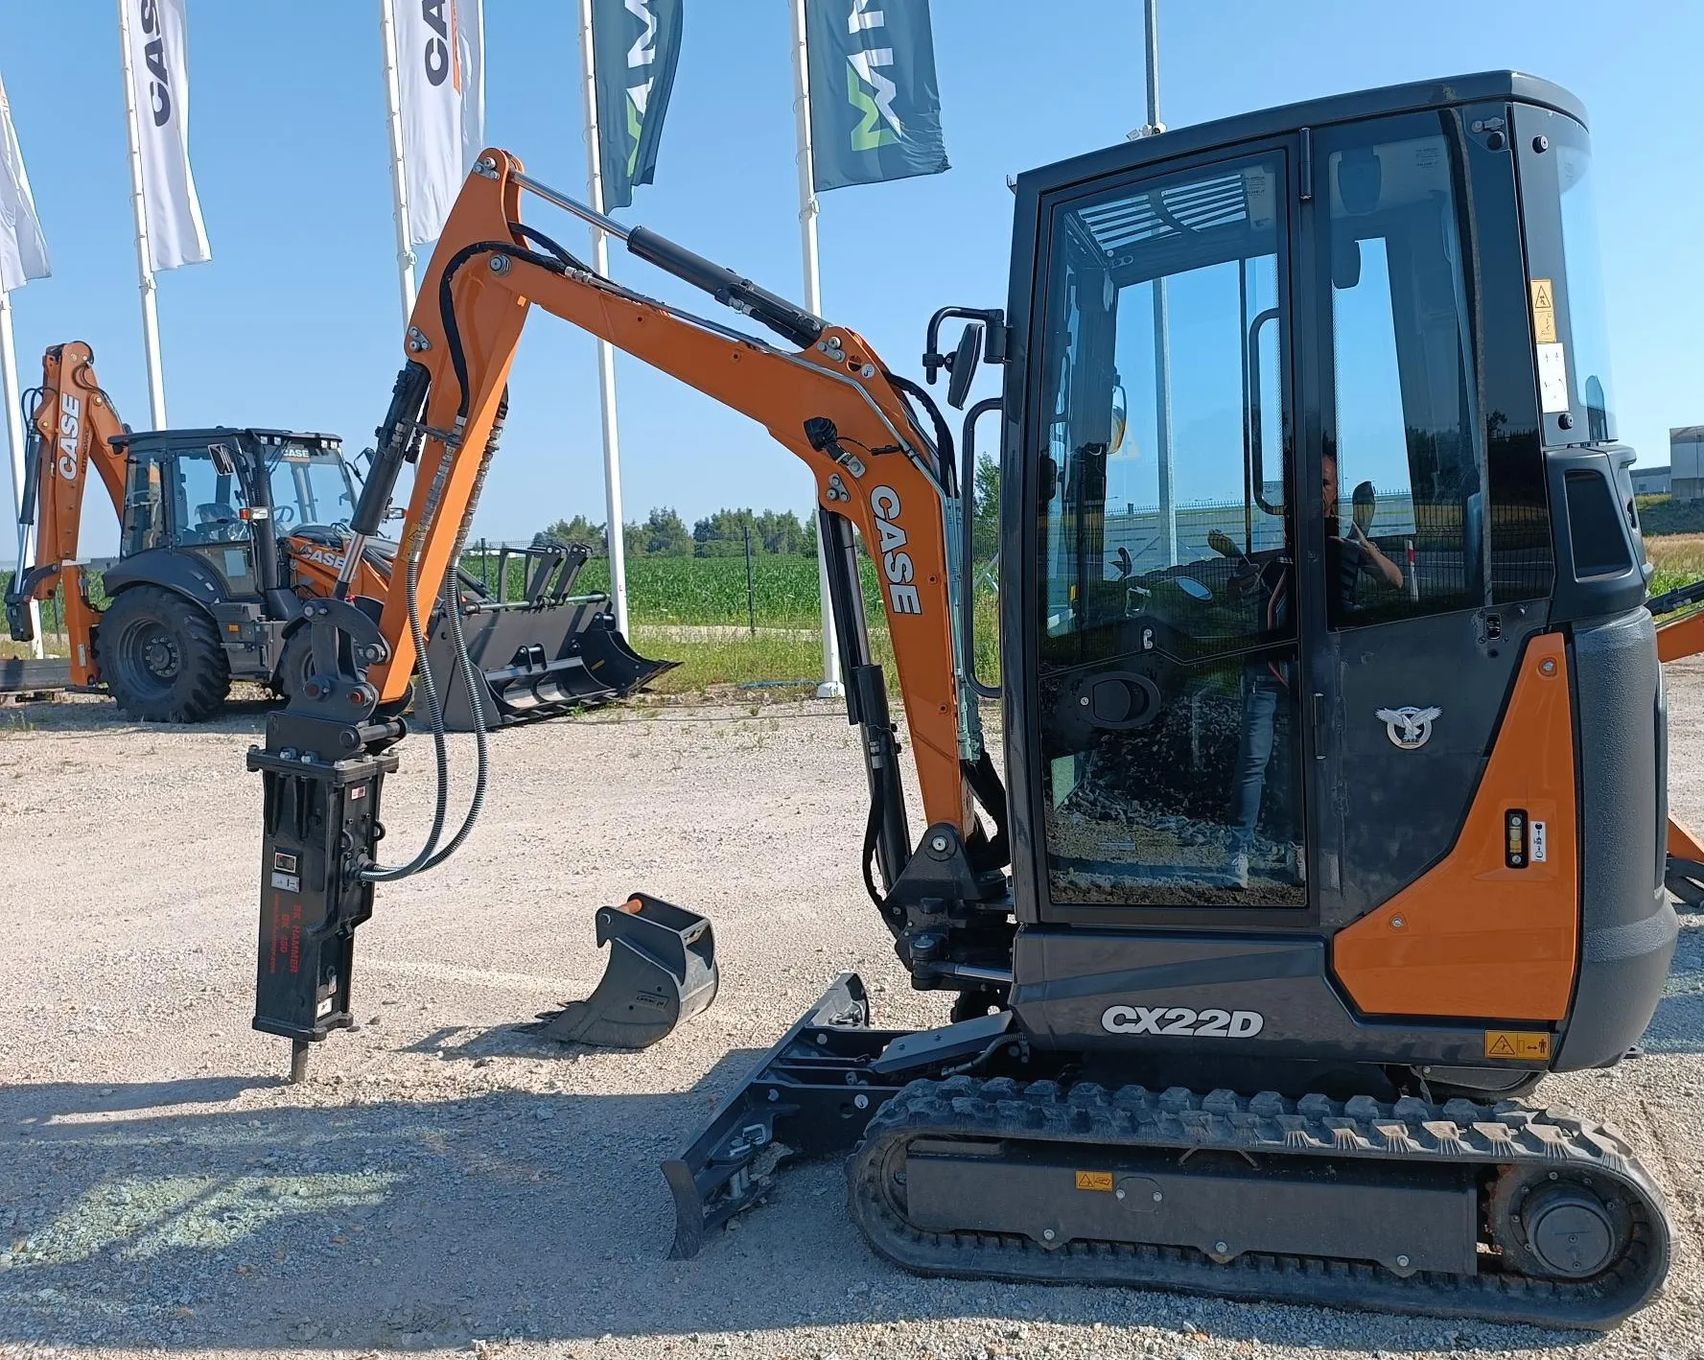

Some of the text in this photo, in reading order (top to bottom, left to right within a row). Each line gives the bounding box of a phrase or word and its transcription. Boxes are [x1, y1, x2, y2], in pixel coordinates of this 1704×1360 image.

[59, 392, 80, 481] CASE
[299, 543, 345, 570] CASE
[870, 485, 923, 615] CASE
[289, 925, 301, 974] HAMMER
[1101, 1005, 1265, 1039] CX22D
